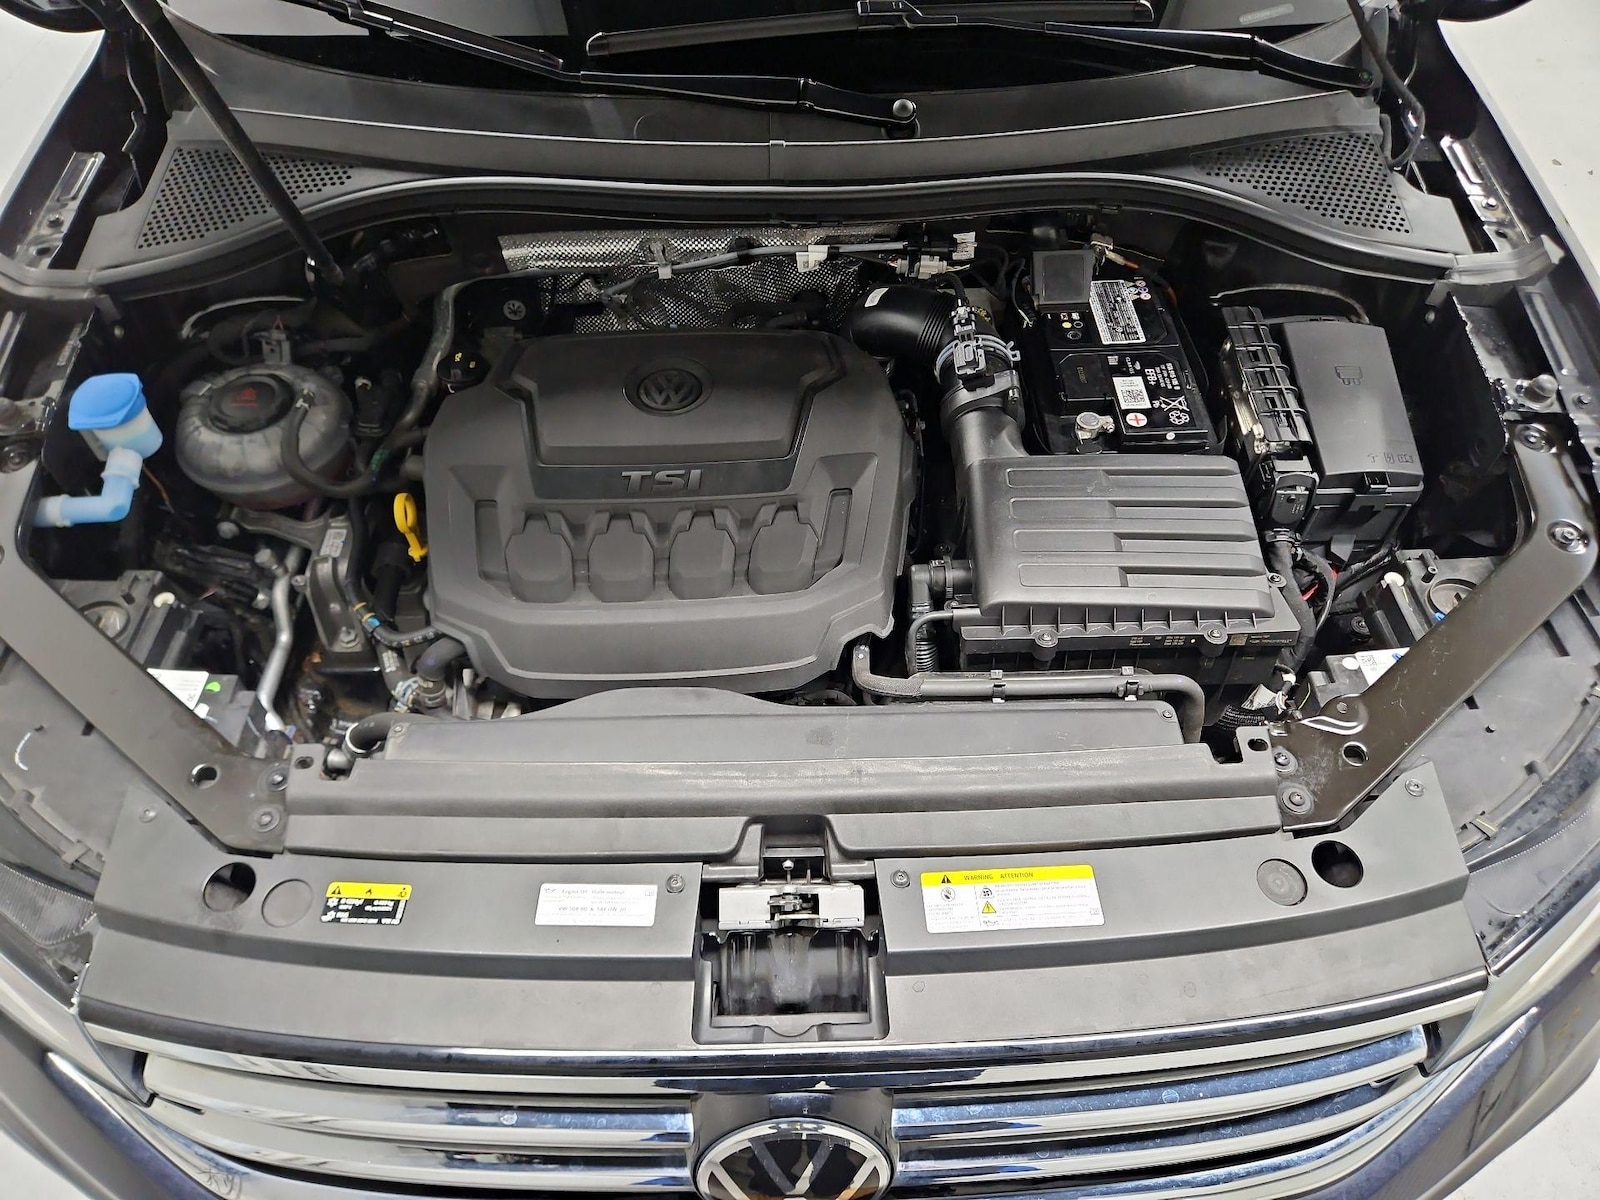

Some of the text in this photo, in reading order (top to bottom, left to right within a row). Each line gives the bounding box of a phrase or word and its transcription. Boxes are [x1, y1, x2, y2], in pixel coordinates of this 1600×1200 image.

[1144, 368, 1158, 386] EFB+
[621, 469, 702, 493] TSI
[963, 873, 993, 881] WARNING
